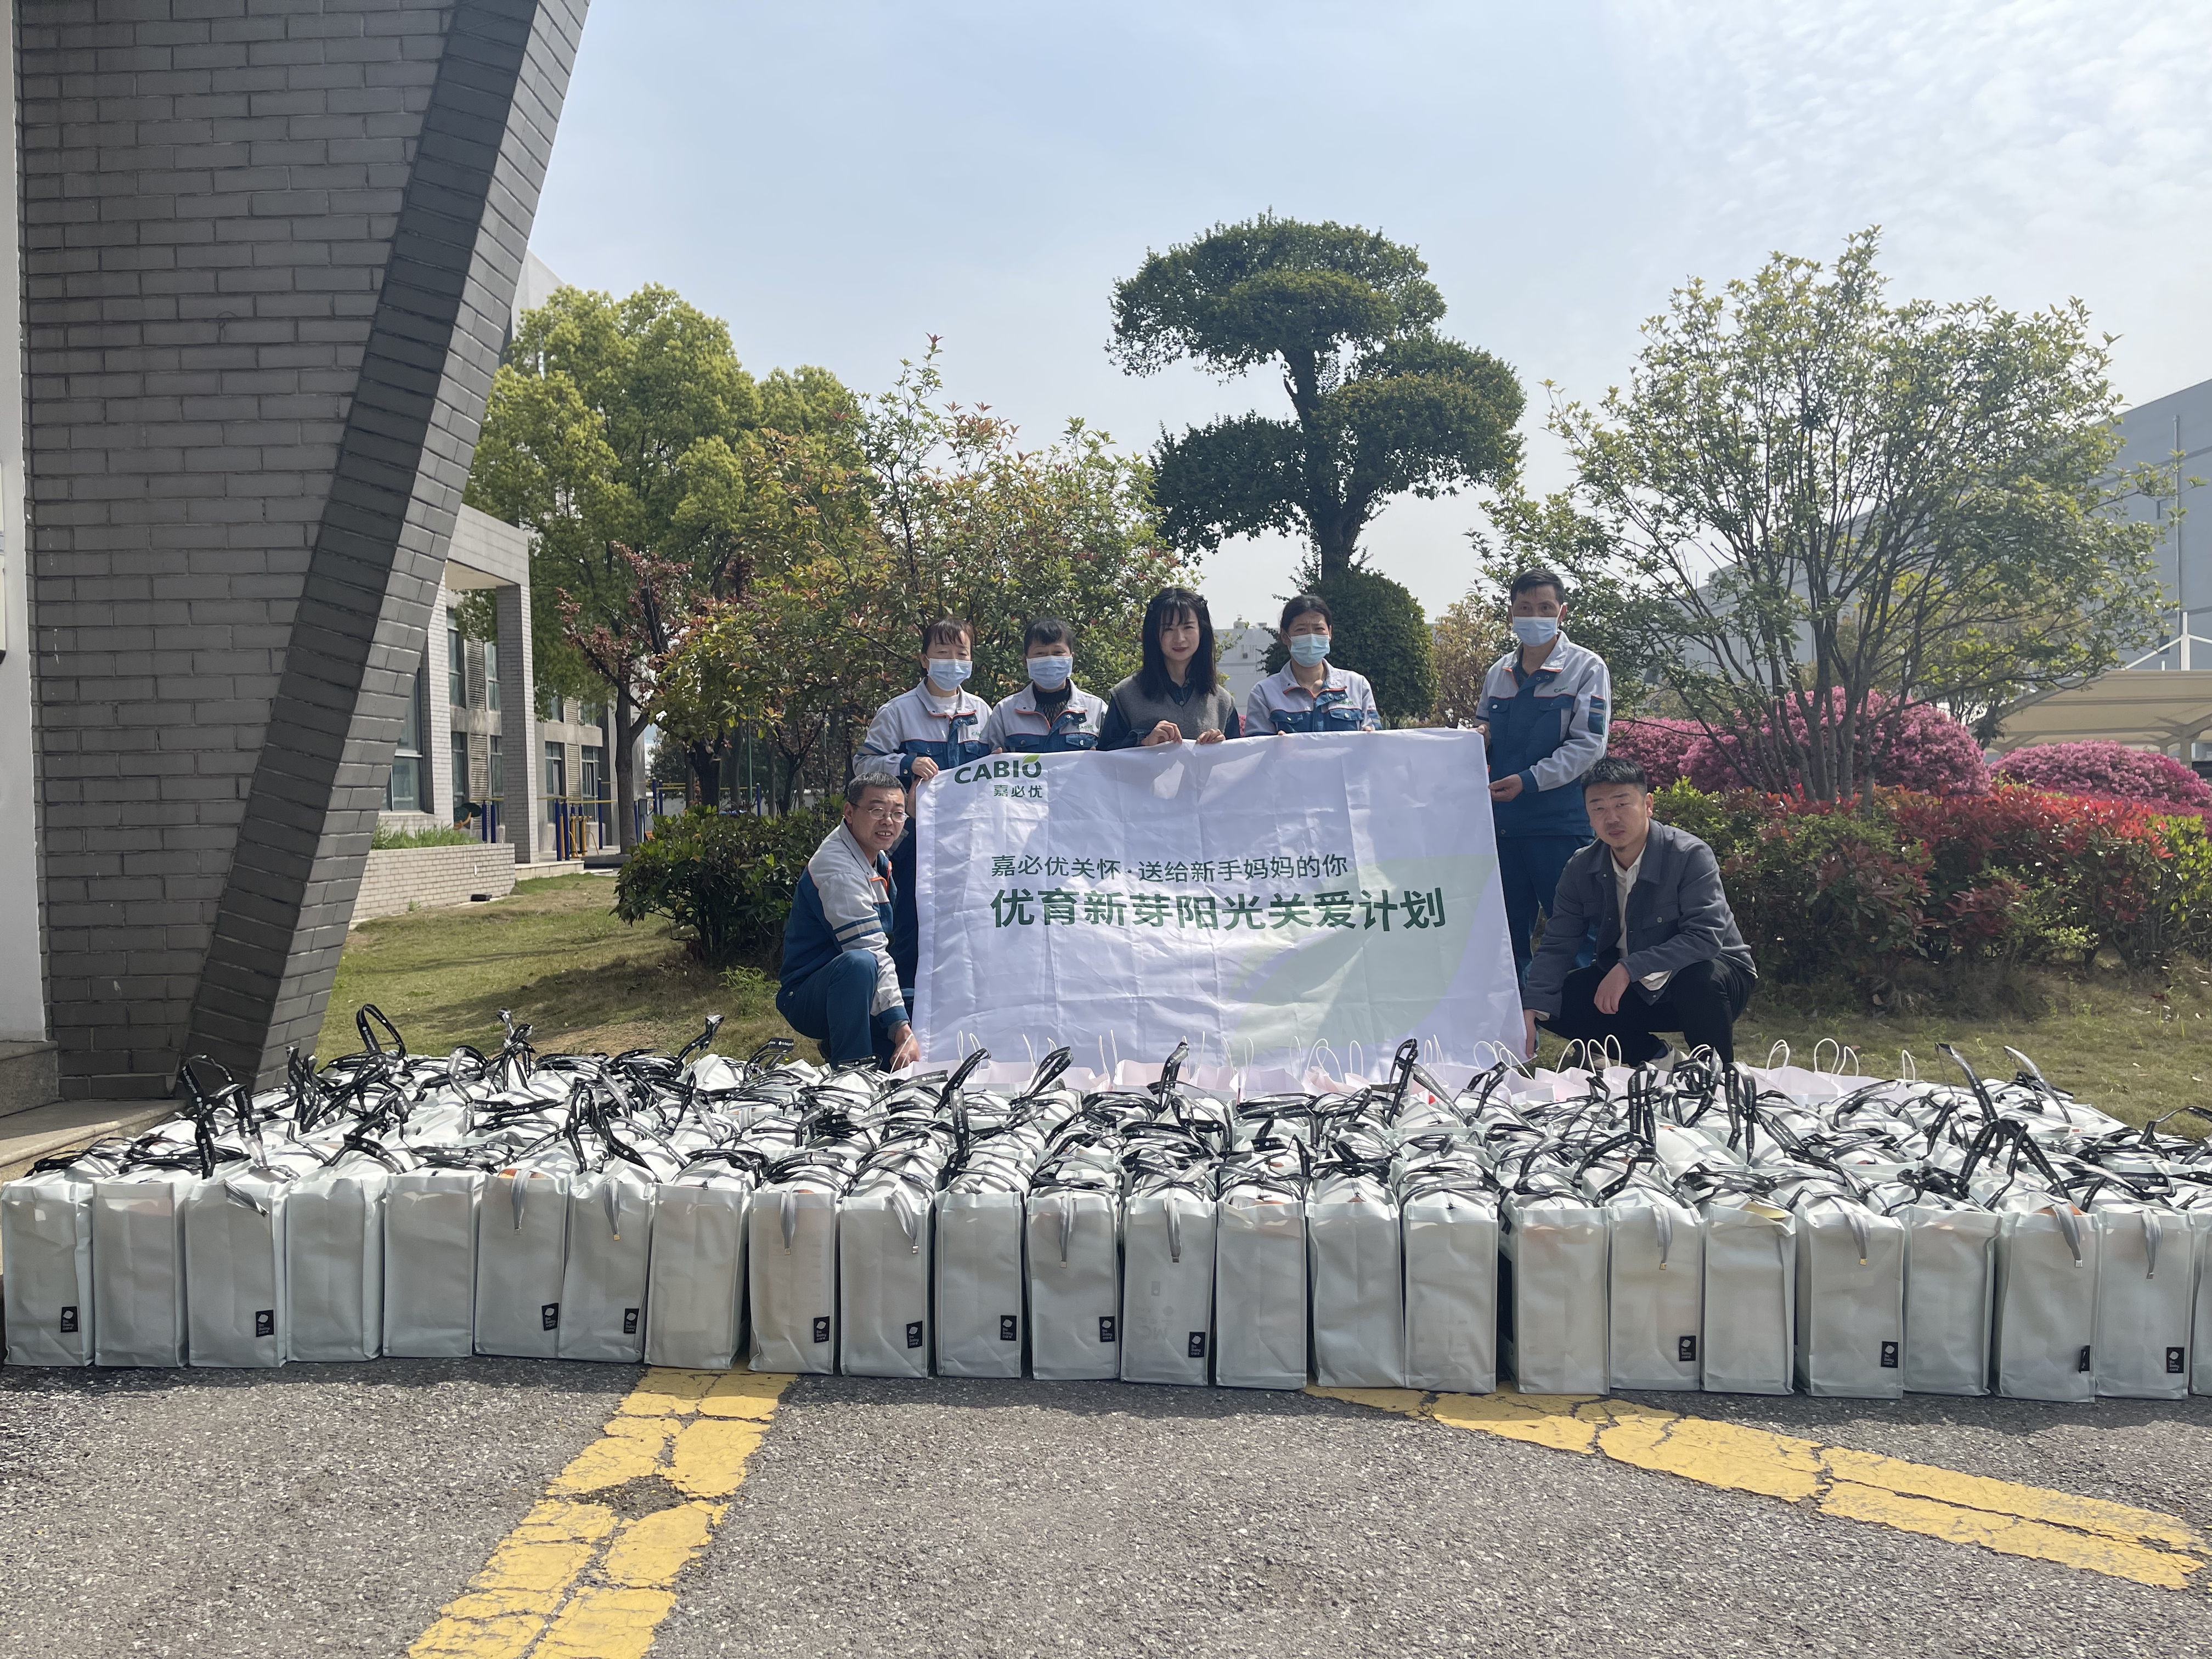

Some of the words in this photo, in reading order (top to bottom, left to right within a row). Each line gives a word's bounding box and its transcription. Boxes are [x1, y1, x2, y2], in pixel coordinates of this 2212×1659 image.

[954, 758, 1042, 784] CABIO
[994, 784, 1043, 798] 嘉必优
[991, 853, 1348, 883] 嘉必优关怀·送给新手妈妈的你
[990, 887, 1446, 932] 优育新芽阳光关爱计划
